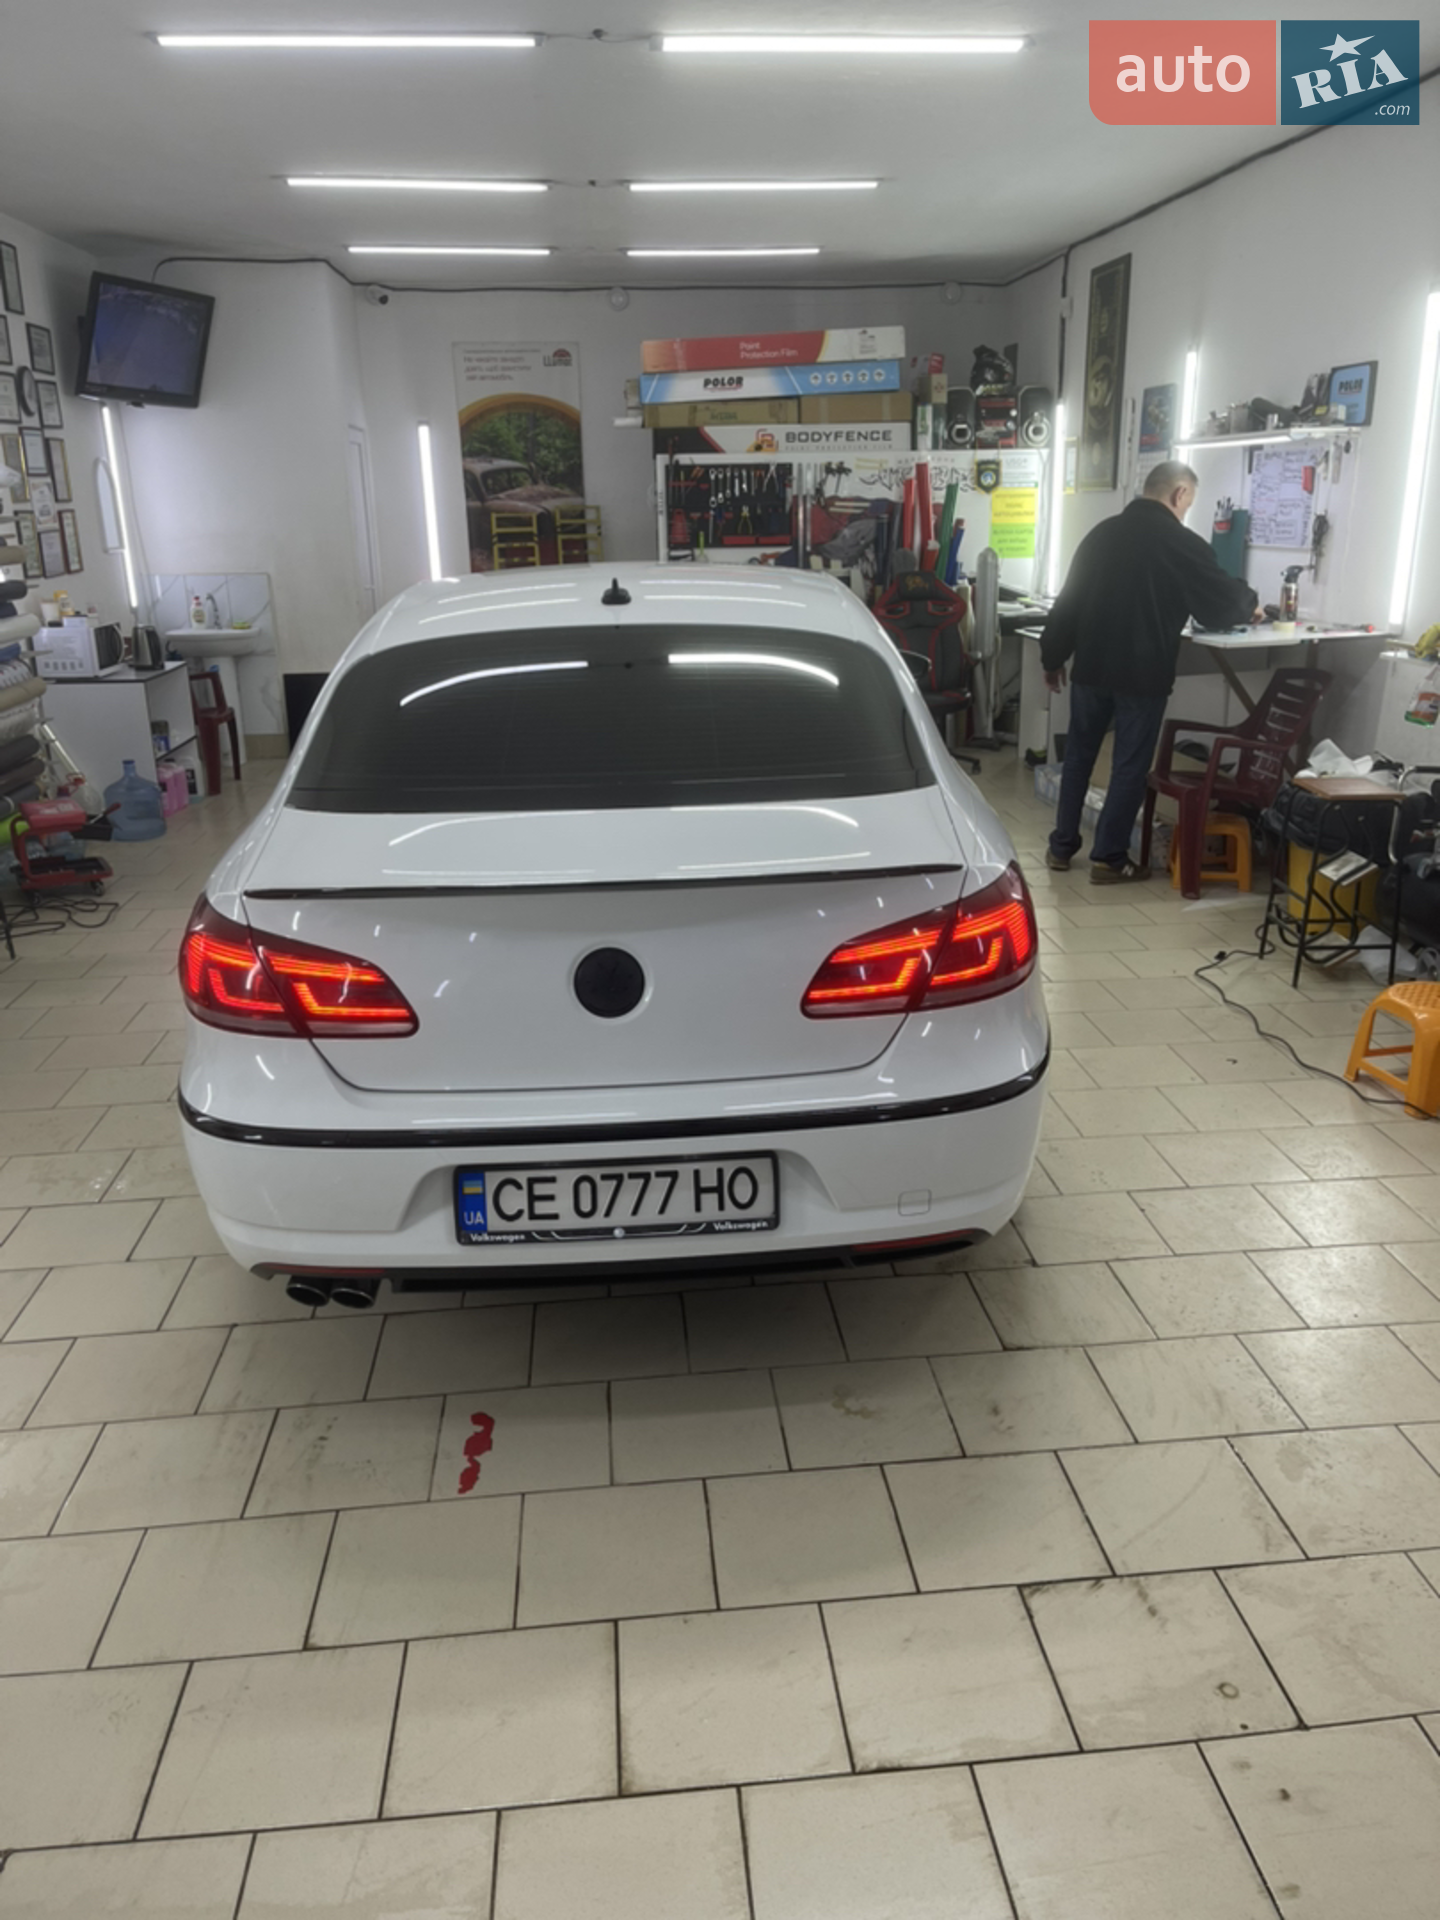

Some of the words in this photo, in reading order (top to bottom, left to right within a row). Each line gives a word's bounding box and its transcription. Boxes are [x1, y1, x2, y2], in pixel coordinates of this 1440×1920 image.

[785, 430, 892, 443] BODYFENCE
[492, 1176, 560, 1222] CE
[573, 1170, 679, 1219] 0777
[693, 1166, 759, 1213] HO
[464, 1211, 485, 1225] UA
